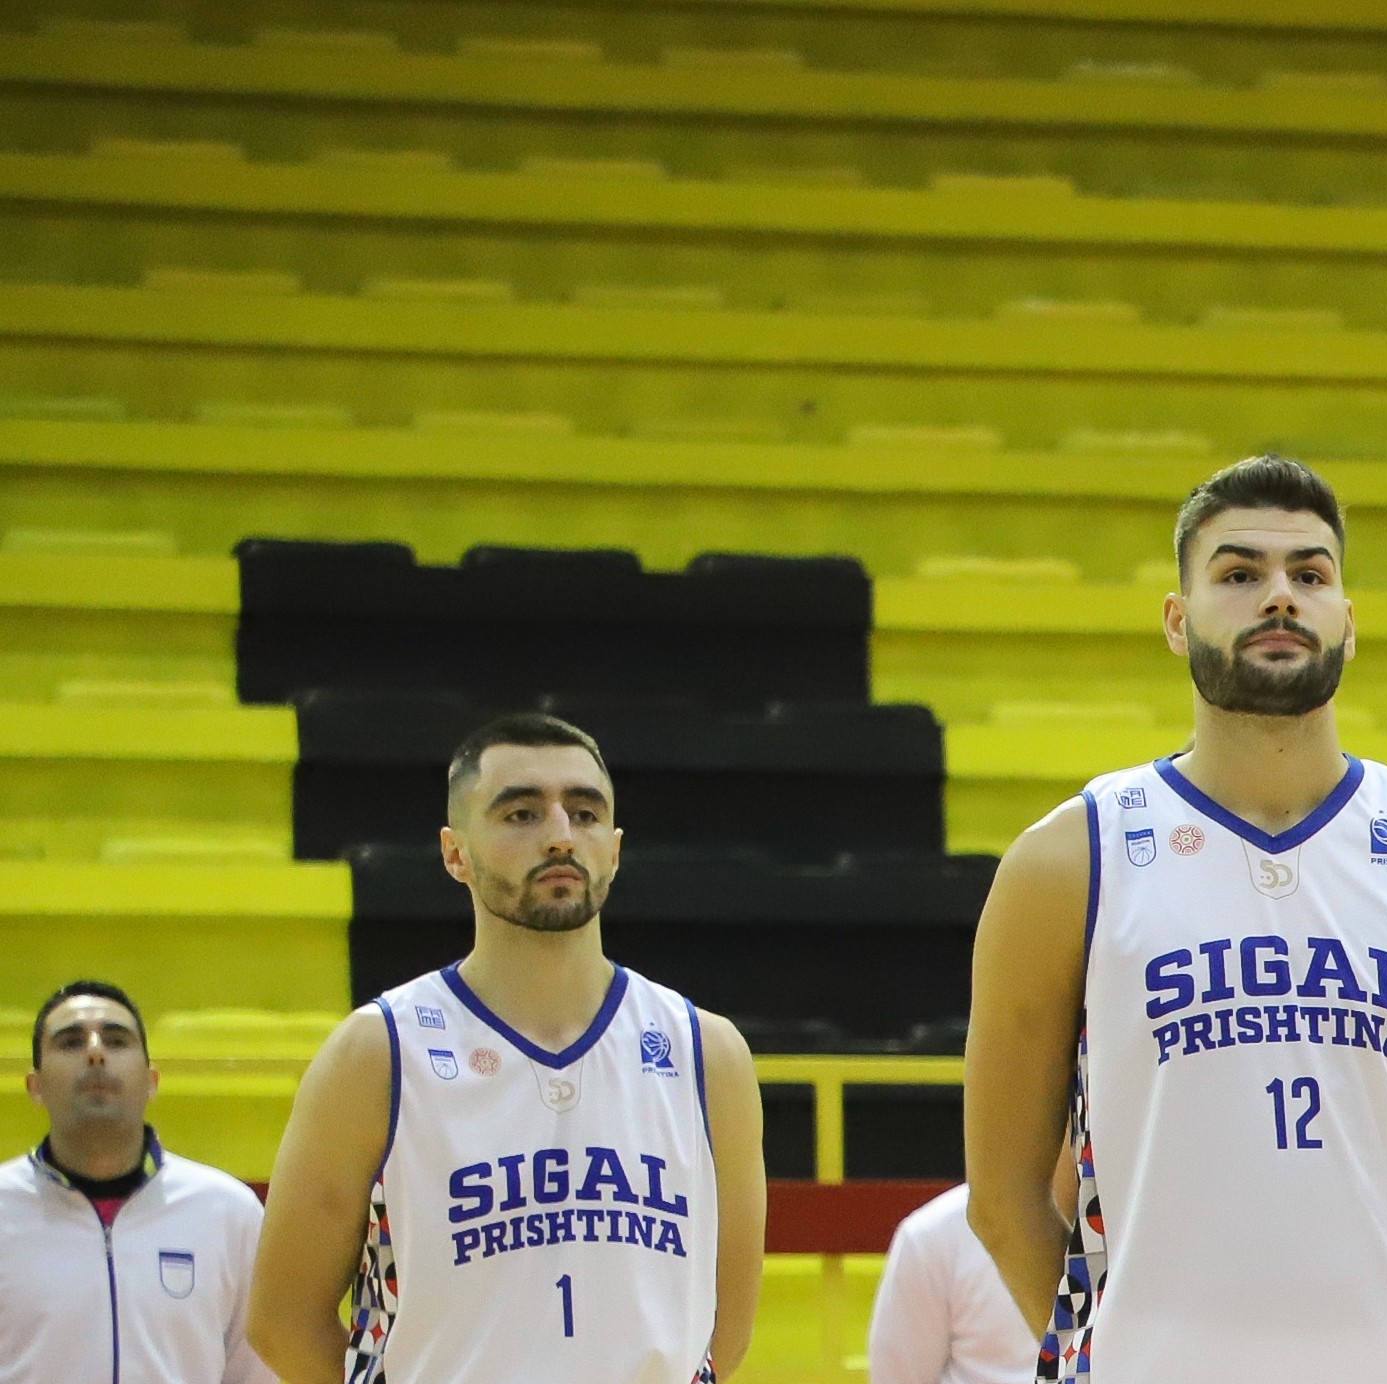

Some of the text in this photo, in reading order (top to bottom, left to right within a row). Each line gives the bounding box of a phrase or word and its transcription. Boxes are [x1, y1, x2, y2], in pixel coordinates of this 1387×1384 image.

[642, 1067, 680, 1078] PRITINA
[1267, 1077, 1323, 1149] 12
[449, 1147, 689, 1223] SIGAL
[451, 1209, 687, 1266] PRISHTINA
[556, 1274, 574, 1338] 1
